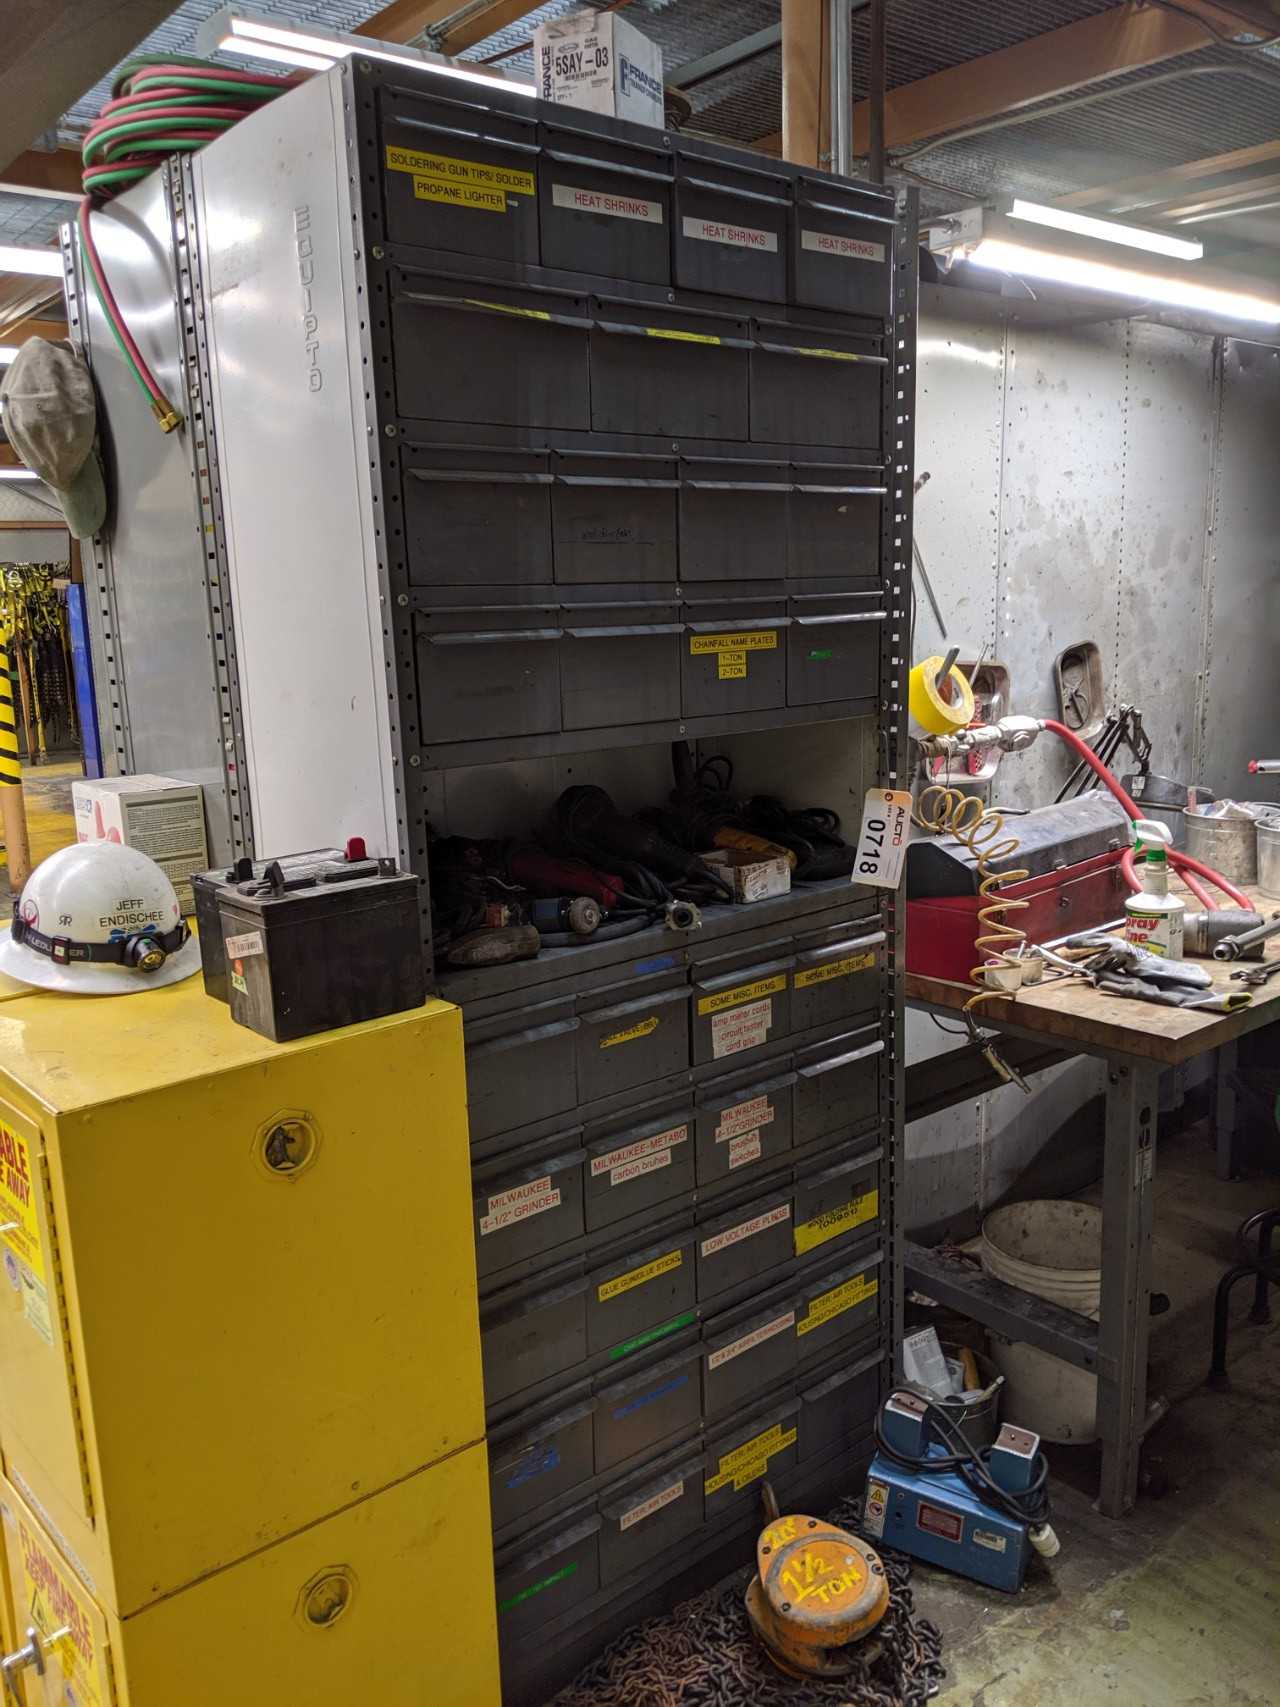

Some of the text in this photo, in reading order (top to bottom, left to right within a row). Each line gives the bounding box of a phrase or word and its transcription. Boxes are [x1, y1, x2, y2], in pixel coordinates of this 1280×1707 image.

[542, 45, 552, 102] RANCE
[630, 63, 662, 95] FRANCE
[391, 152, 446, 174] SOLDERING
[448, 164, 469, 178] GUN
[495, 172, 532, 189] SOLDER
[417, 181, 503, 206] PROPANE LIGHTER
[574, 191, 649, 217] HEAT SHRINKS
[702, 223, 766, 246] HEAT SHRINKS
[817, 236, 874, 257] HEAT SHRINKS
[294, 205, 323, 393] EQUIPTO
[694, 635, 775, 651] CHAINFALL NAME PLATES
[722, 653, 743, 663] 1-TON
[722, 666, 743, 676] 2-TON
[859, 819, 886, 875] 0718
[116, 899, 144, 911] JEFF
[99, 911, 164, 928] ENDISCHEE
[710, 994, 732, 1008] SOME
[753, 981, 776, 995] ITEMS
[721, 1101, 767, 1122] MILWAUKEE
[593, 1129, 686, 1170] MILWAUKEE-METABO
[612, 1163, 640, 1181] carbon
[7, 1167, 31, 1208] AWAY
[489, 1179, 550, 1209] MILWAUKEE
[513, 1192, 559, 1217] GRINDER
[705, 1238, 724, 1252] LOW
[725, 1221, 761, 1243] VOLTAGE
[843, 1278, 863, 1294] TOOLS
[810, 1566, 861, 1603] TON
